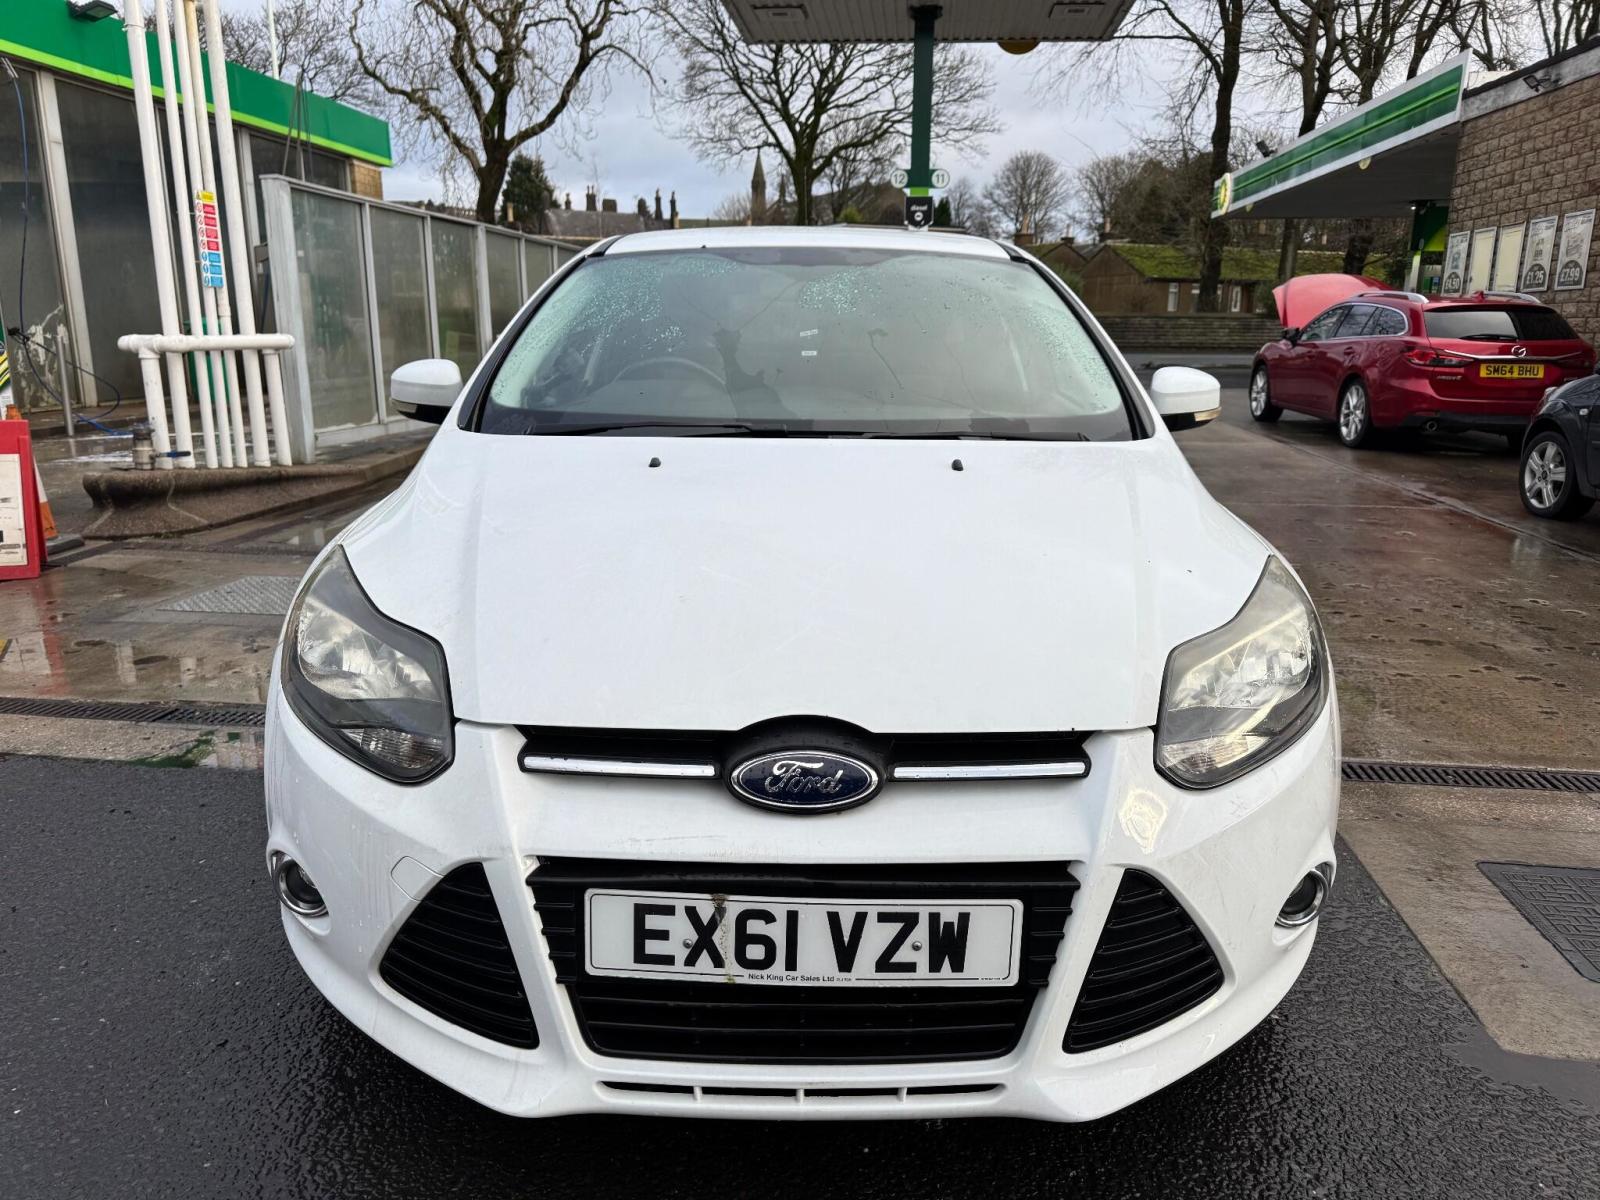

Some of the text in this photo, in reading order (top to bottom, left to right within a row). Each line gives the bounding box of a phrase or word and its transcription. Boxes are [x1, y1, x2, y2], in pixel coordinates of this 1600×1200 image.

[894, 174, 905, 184] 12
[936, 174, 945, 184] 11
[1526, 270, 1544, 284] £1.25
[1560, 269, 1580, 282] £7.99
[1485, 365, 1539, 376] SM64 BHU
[764, 760, 844, 794] Ford
[633, 903, 971, 973] EX61 VZW
[767, 974, 784, 982] King
